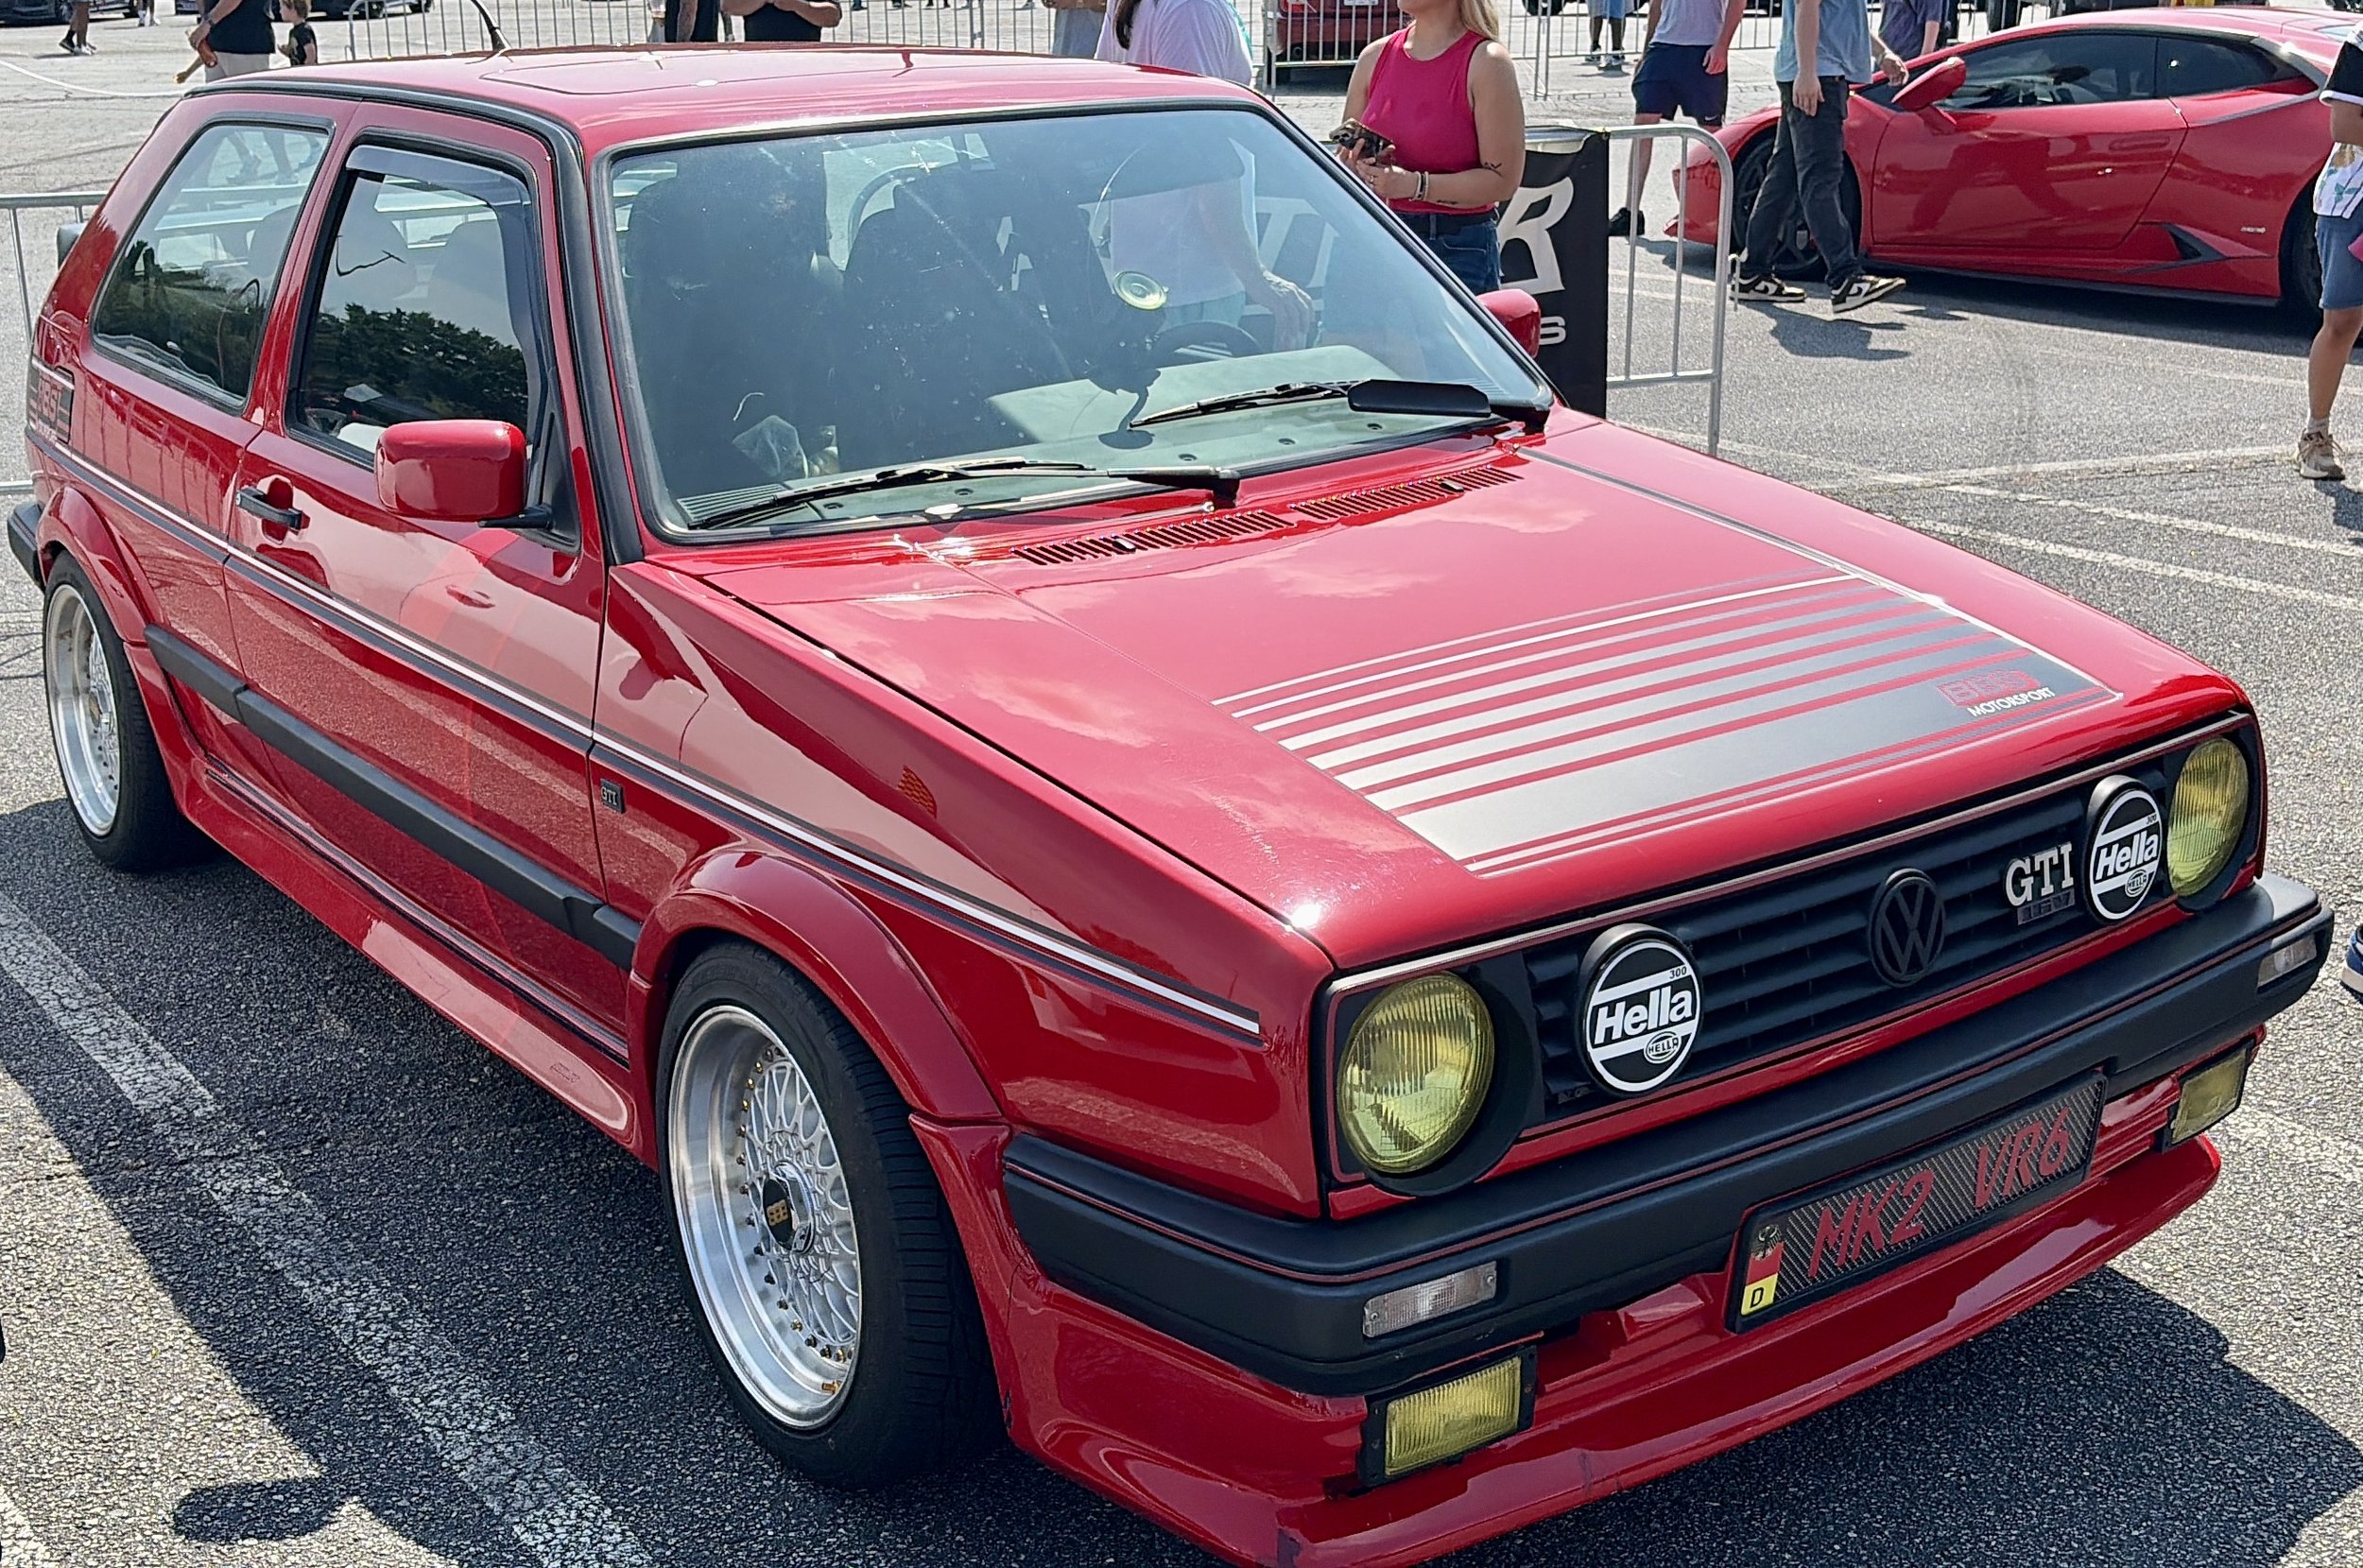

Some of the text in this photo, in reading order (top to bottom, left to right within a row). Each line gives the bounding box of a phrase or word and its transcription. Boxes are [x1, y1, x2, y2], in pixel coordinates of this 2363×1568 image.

[1967, 687, 2055, 716] MOTORSPORT
[601, 786, 617, 805] GTI
[2096, 831, 2159, 881] Hella
[2005, 841, 2074, 906] GTI
[1669, 965, 1687, 979] 300
[1594, 986, 1693, 1044] Hella
[1647, 1037, 1680, 1054] HELLA
[1808, 1106, 2069, 1278] MK2 VR6
[1750, 1286, 1765, 1308] D
